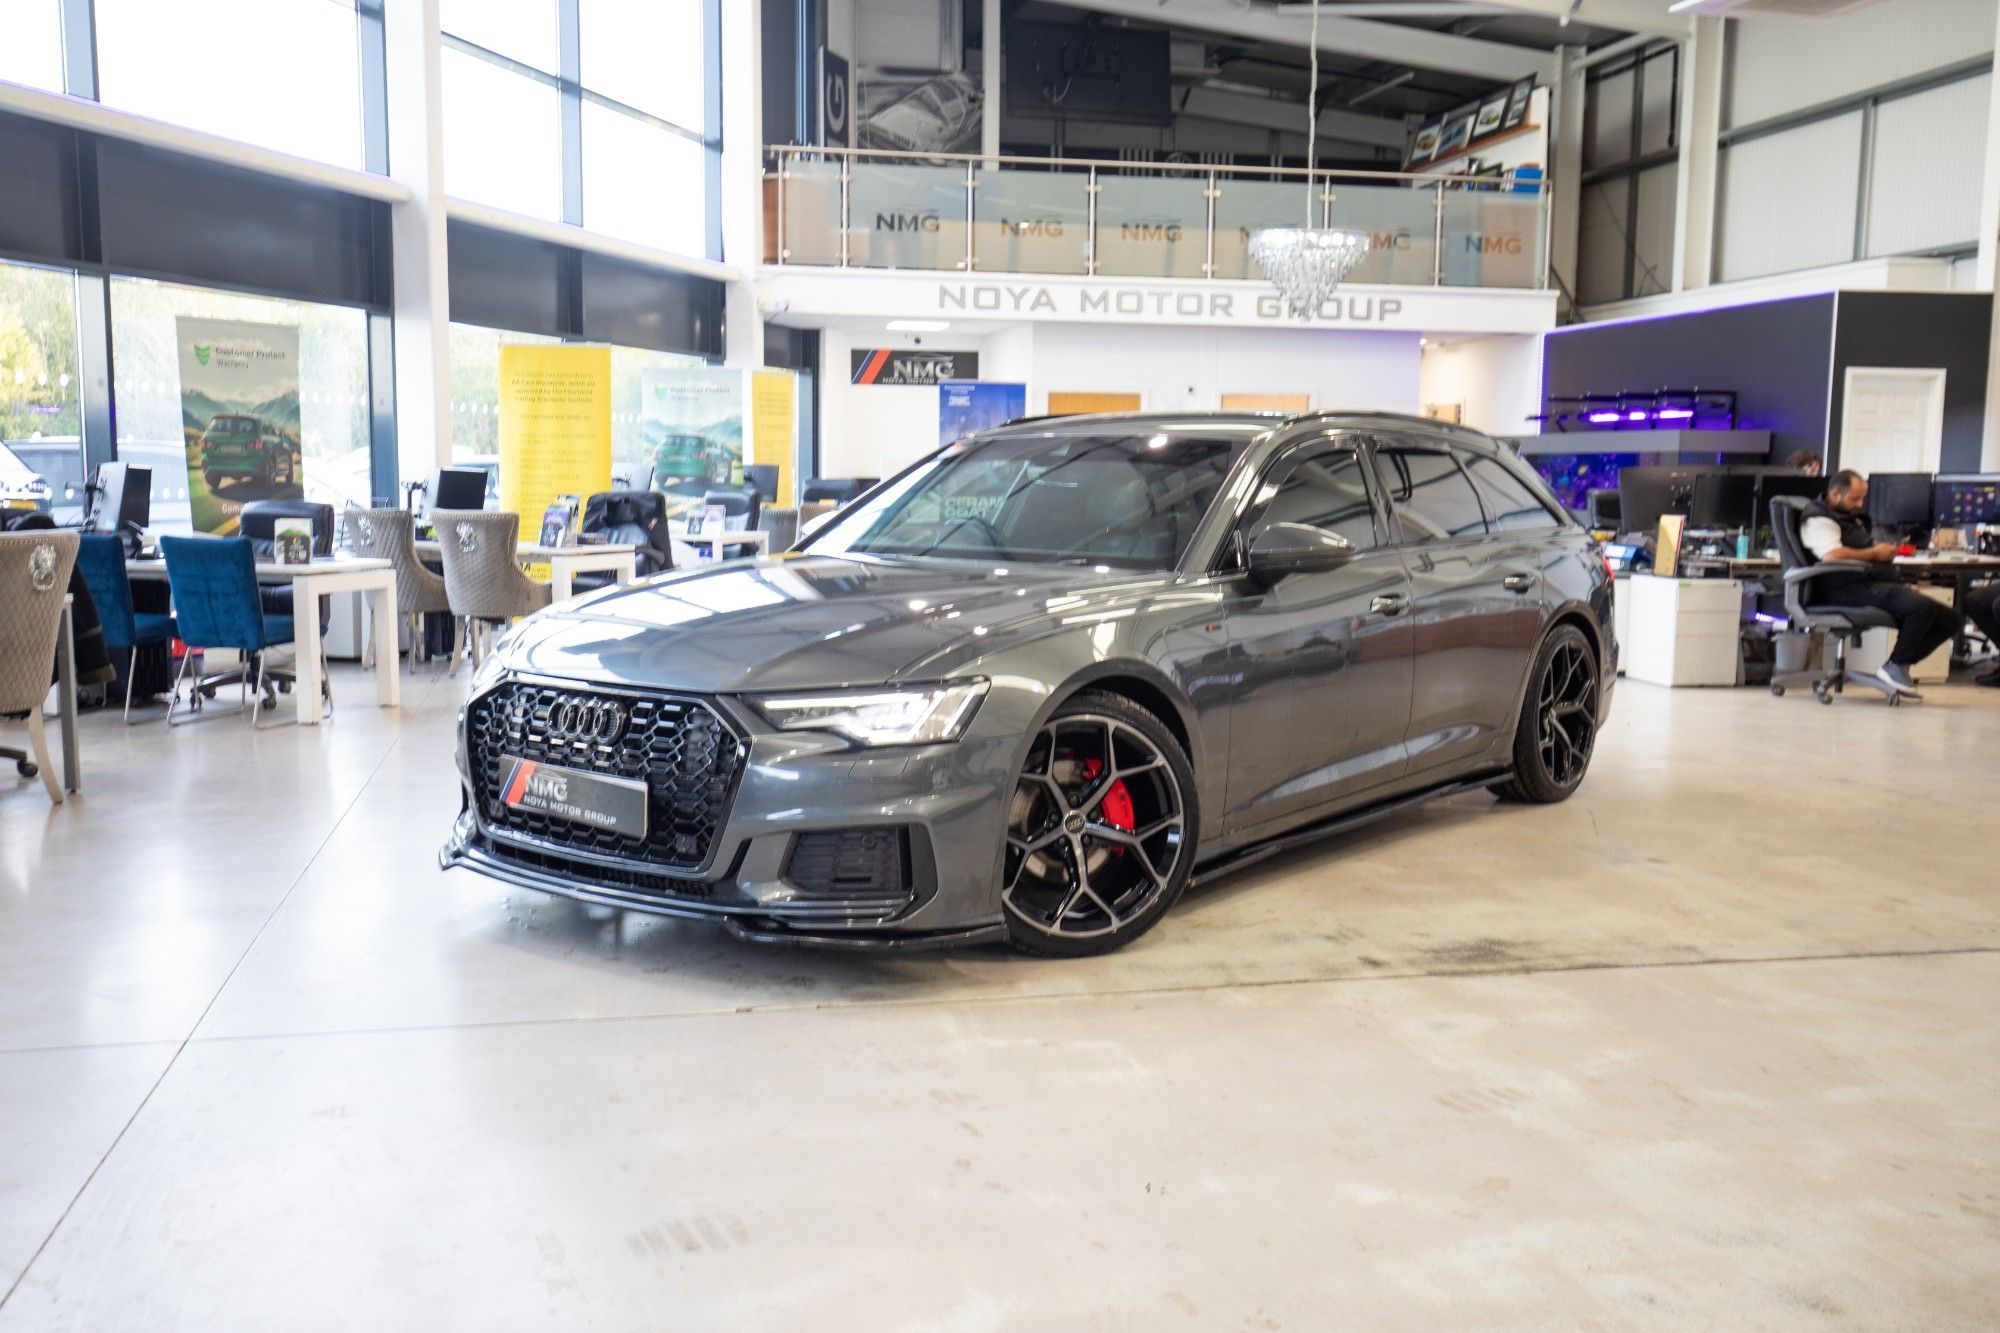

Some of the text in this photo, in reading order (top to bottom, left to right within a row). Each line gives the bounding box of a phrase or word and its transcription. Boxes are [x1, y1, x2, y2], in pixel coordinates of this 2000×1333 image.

[876, 213, 940, 233] NMG
[1001, 217, 1064, 237] NMG
[1122, 222, 1182, 242] NMG
[1372, 231, 1411, 250] MG
[1466, 234, 1522, 254] NMG
[939, 284, 1057, 312] NOYA
[1080, 288, 1234, 317] MOTOR
[893, 359, 954, 378] NMG
[525, 775, 568, 801] NMG
[524, 794, 617, 825] NOYA MOTOR GROUP
